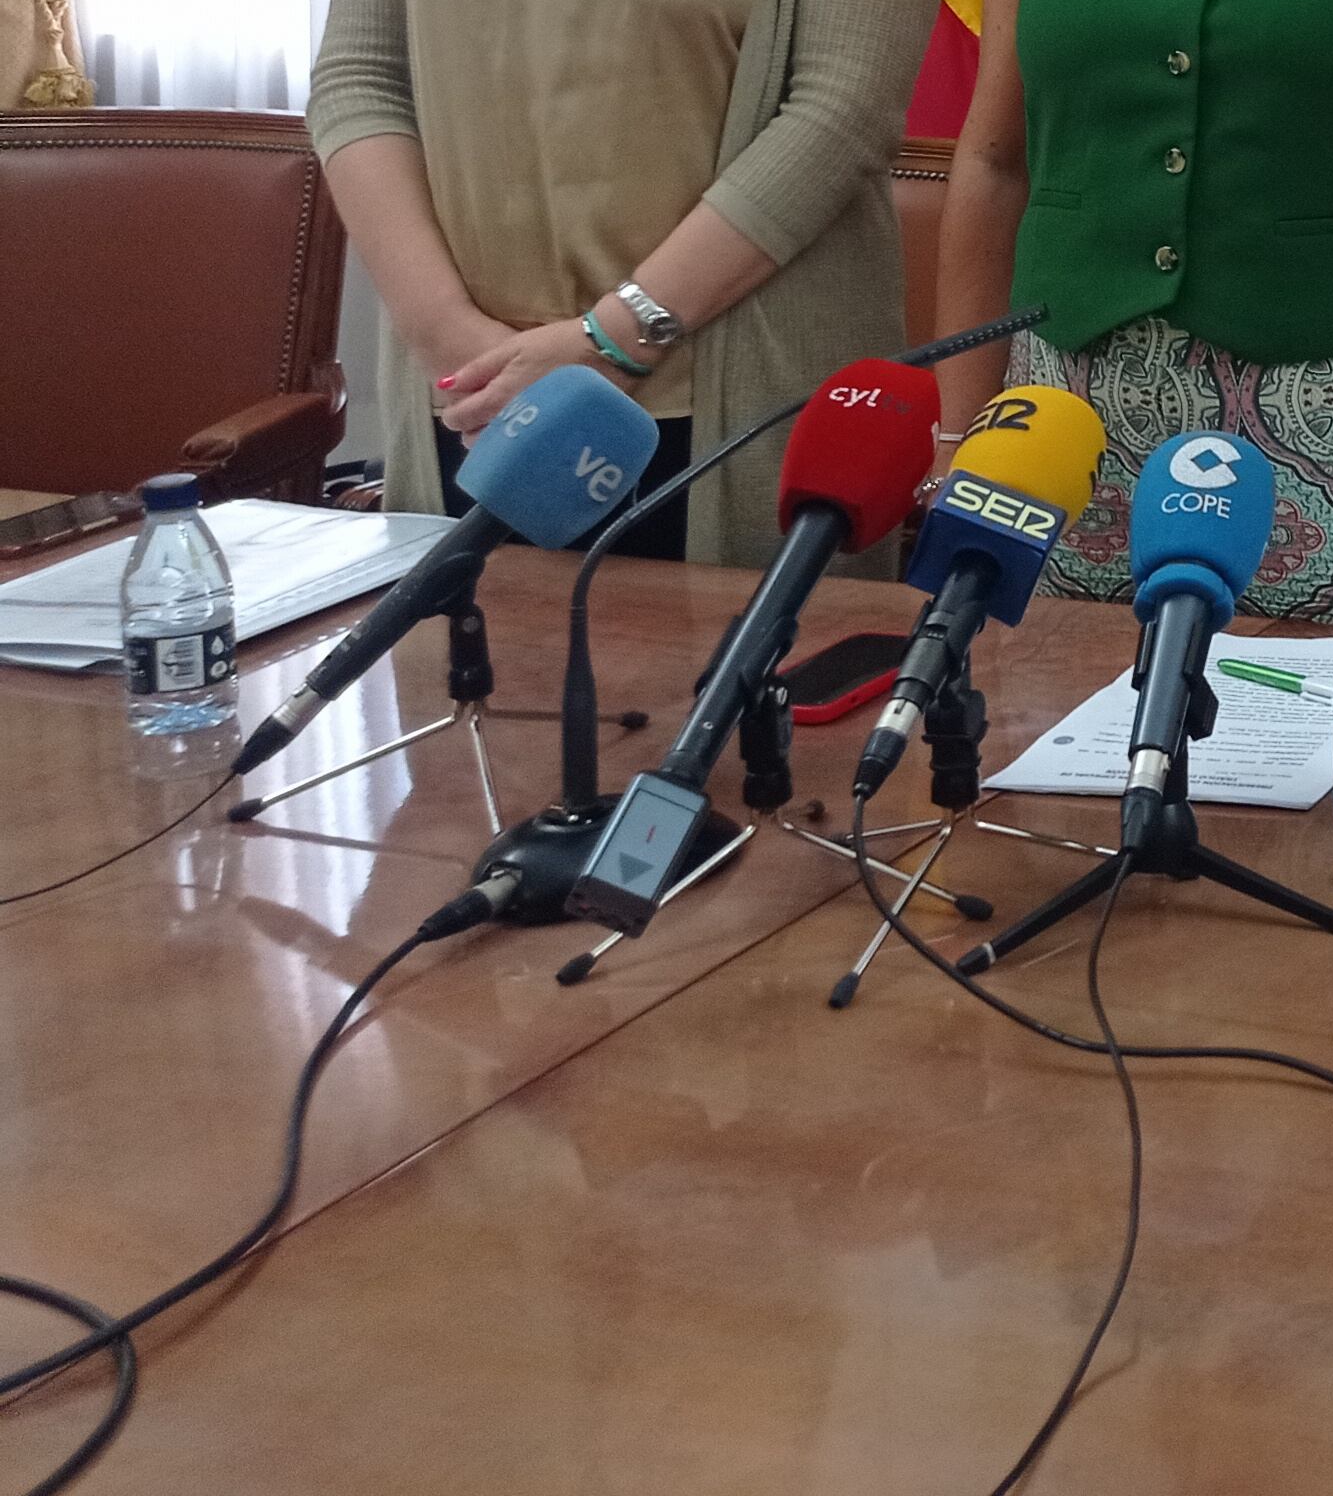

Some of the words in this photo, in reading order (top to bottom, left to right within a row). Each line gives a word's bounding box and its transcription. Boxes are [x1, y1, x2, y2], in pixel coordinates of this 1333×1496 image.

[828, 386, 882, 408] cyl
[575, 445, 624, 503] ve
[945, 479, 1056, 541] SER
[1160, 492, 1232, 519] COPE
